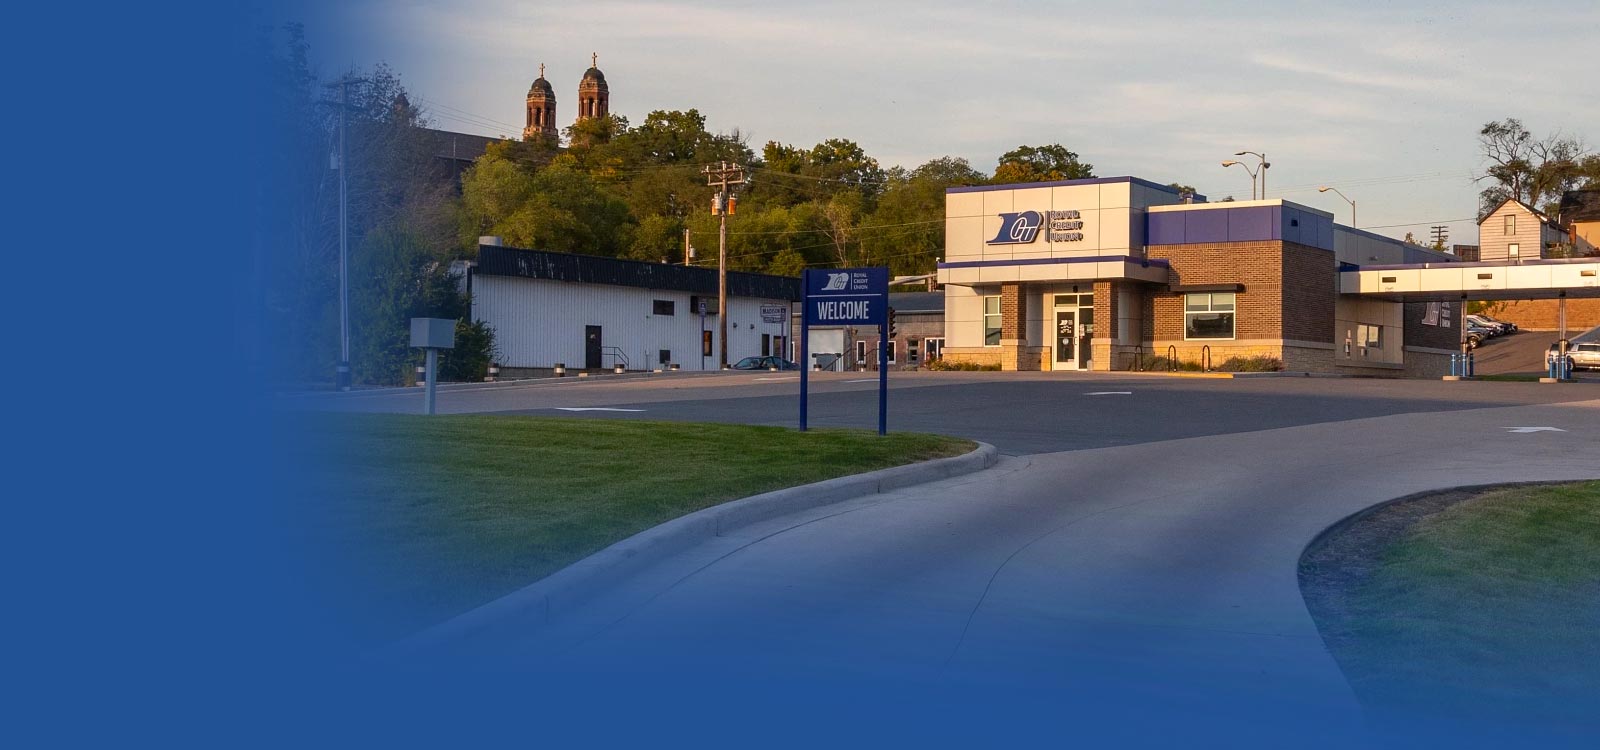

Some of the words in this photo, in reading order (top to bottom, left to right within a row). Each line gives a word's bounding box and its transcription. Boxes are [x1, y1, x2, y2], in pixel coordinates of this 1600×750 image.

[1050, 210, 1080, 220] ROYAL
[1050, 221, 1083, 230] CREDIT
[1050, 232, 1083, 242] UNION
[817, 301, 870, 320] WELCOME
